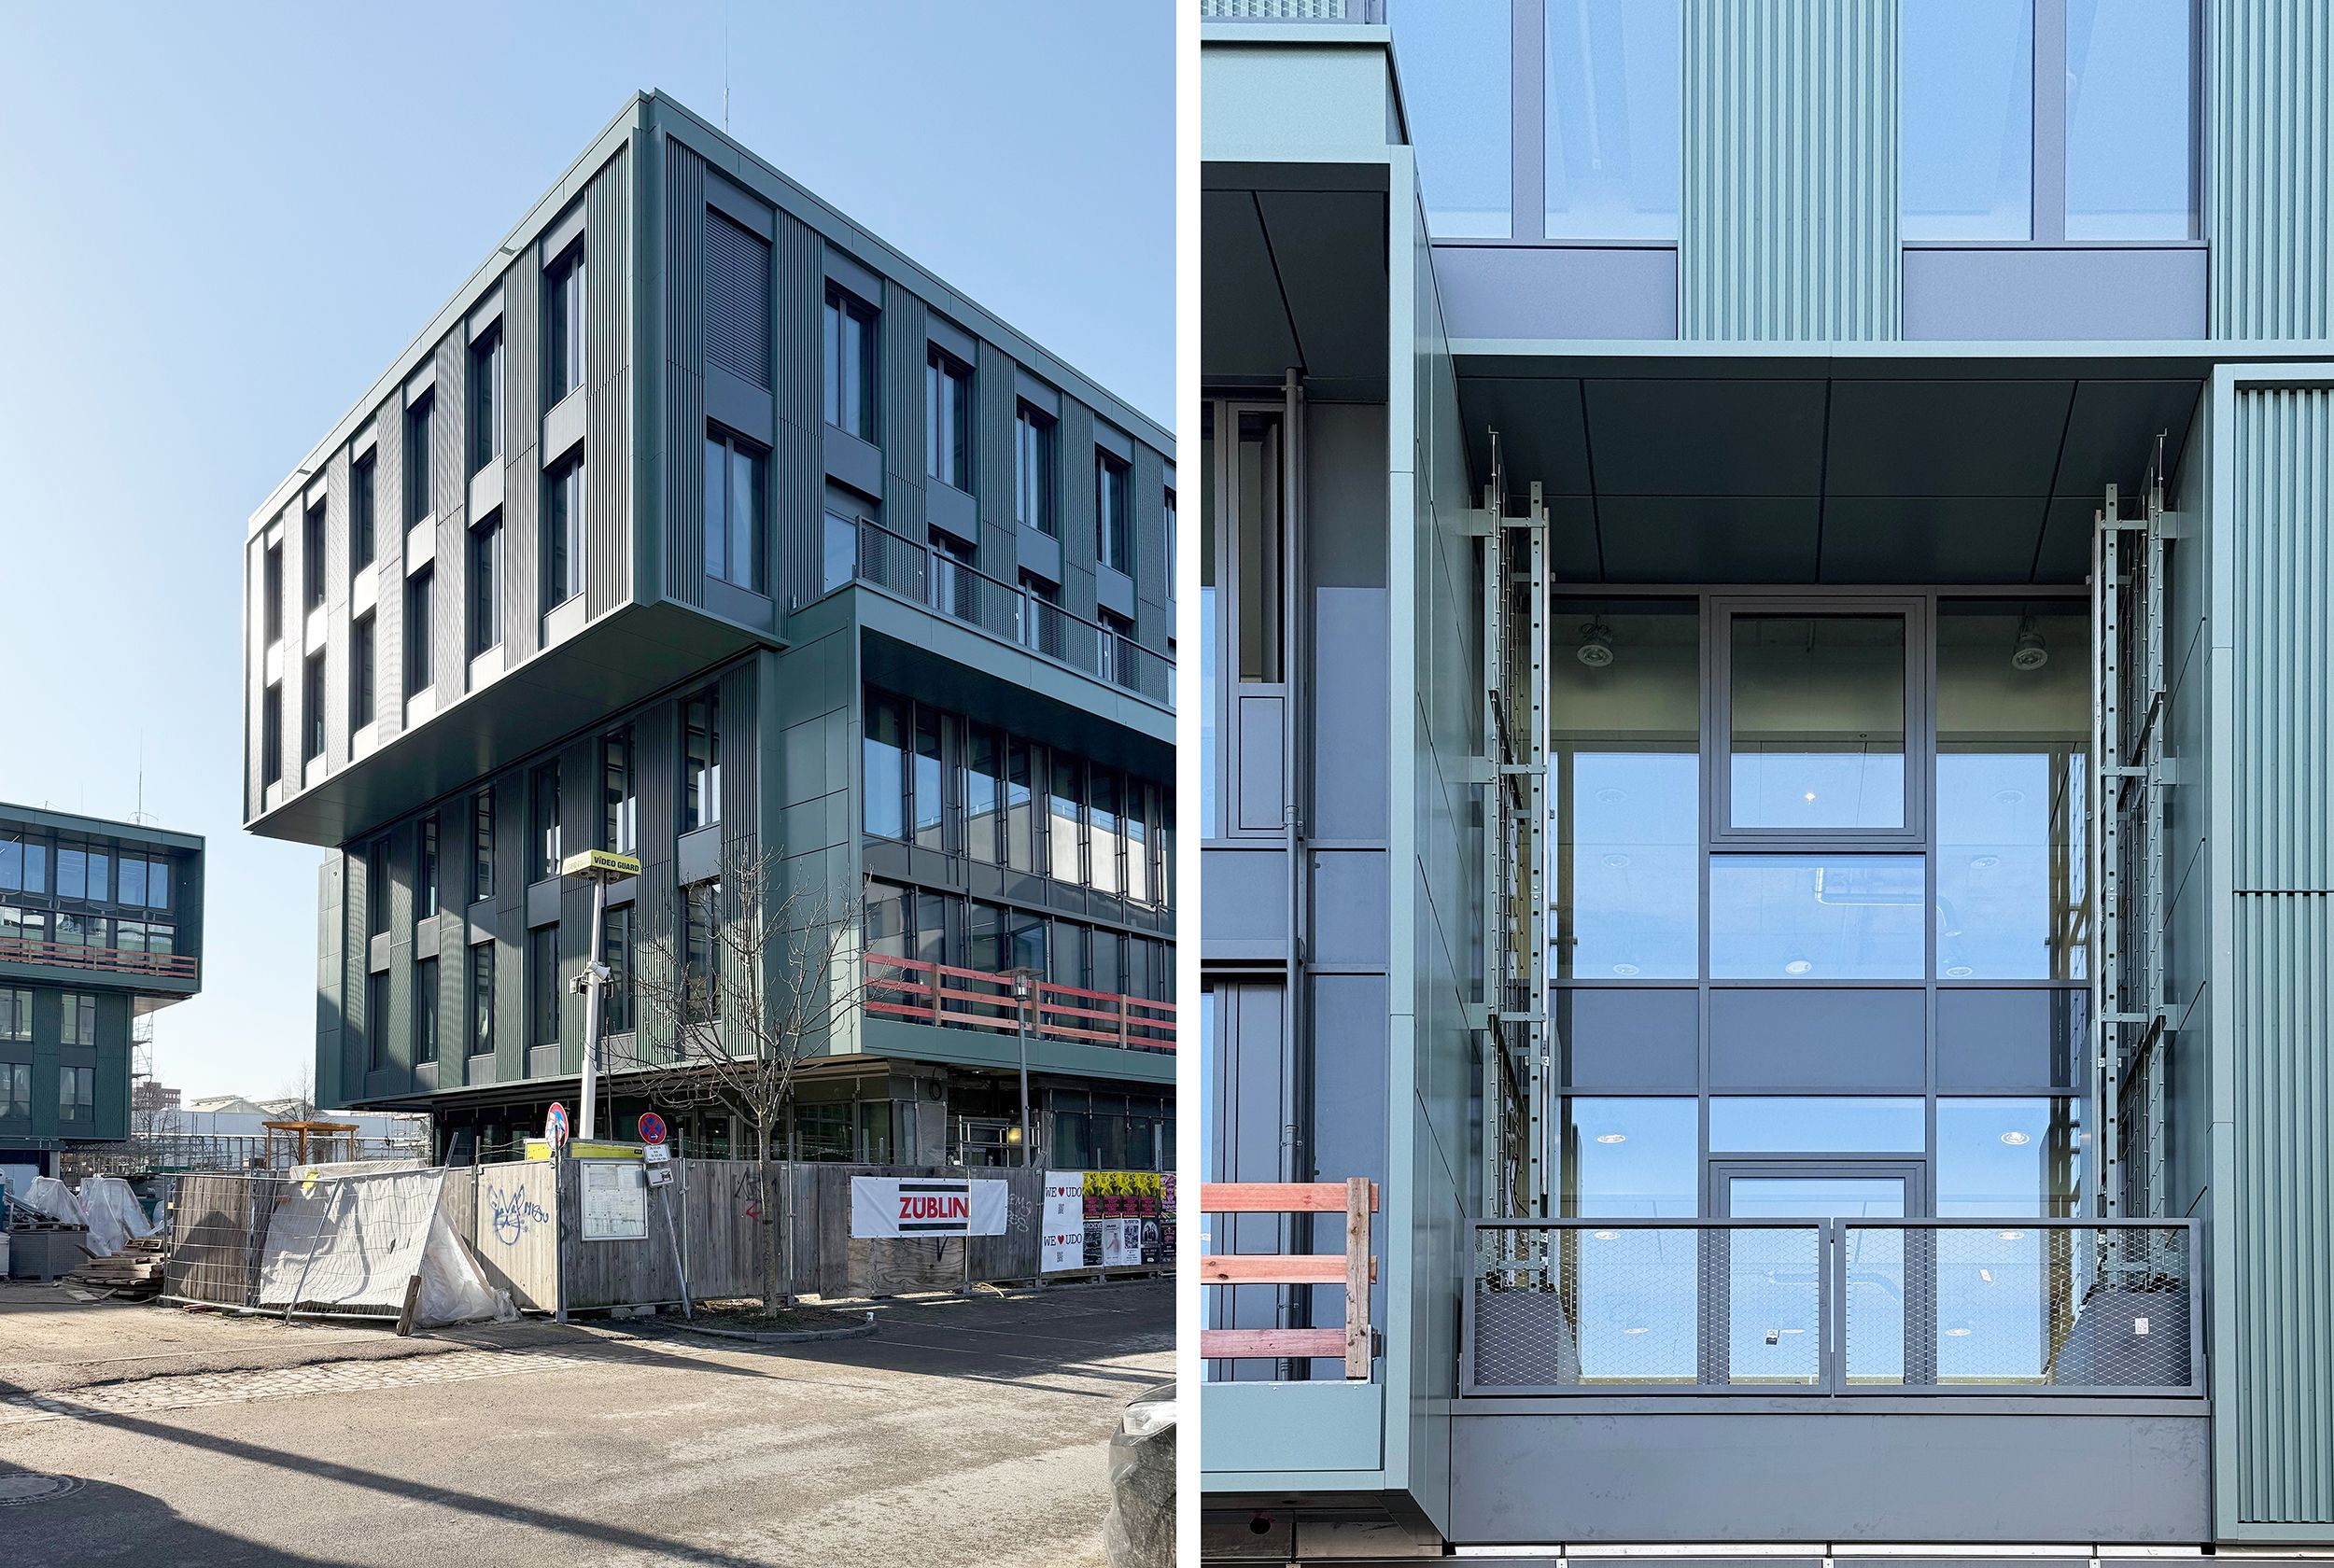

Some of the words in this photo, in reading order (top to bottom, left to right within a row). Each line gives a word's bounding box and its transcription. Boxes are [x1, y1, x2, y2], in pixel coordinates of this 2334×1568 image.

[617, 861, 640, 872] GUARD
[1045, 1186, 1057, 1197] WE
[1065, 1186, 1082, 1197] UDO
[898, 1197, 969, 1219] ZÜBLIN
[1043, 1235, 1056, 1247] WE
[1065, 1233, 1082, 1244] UDO
